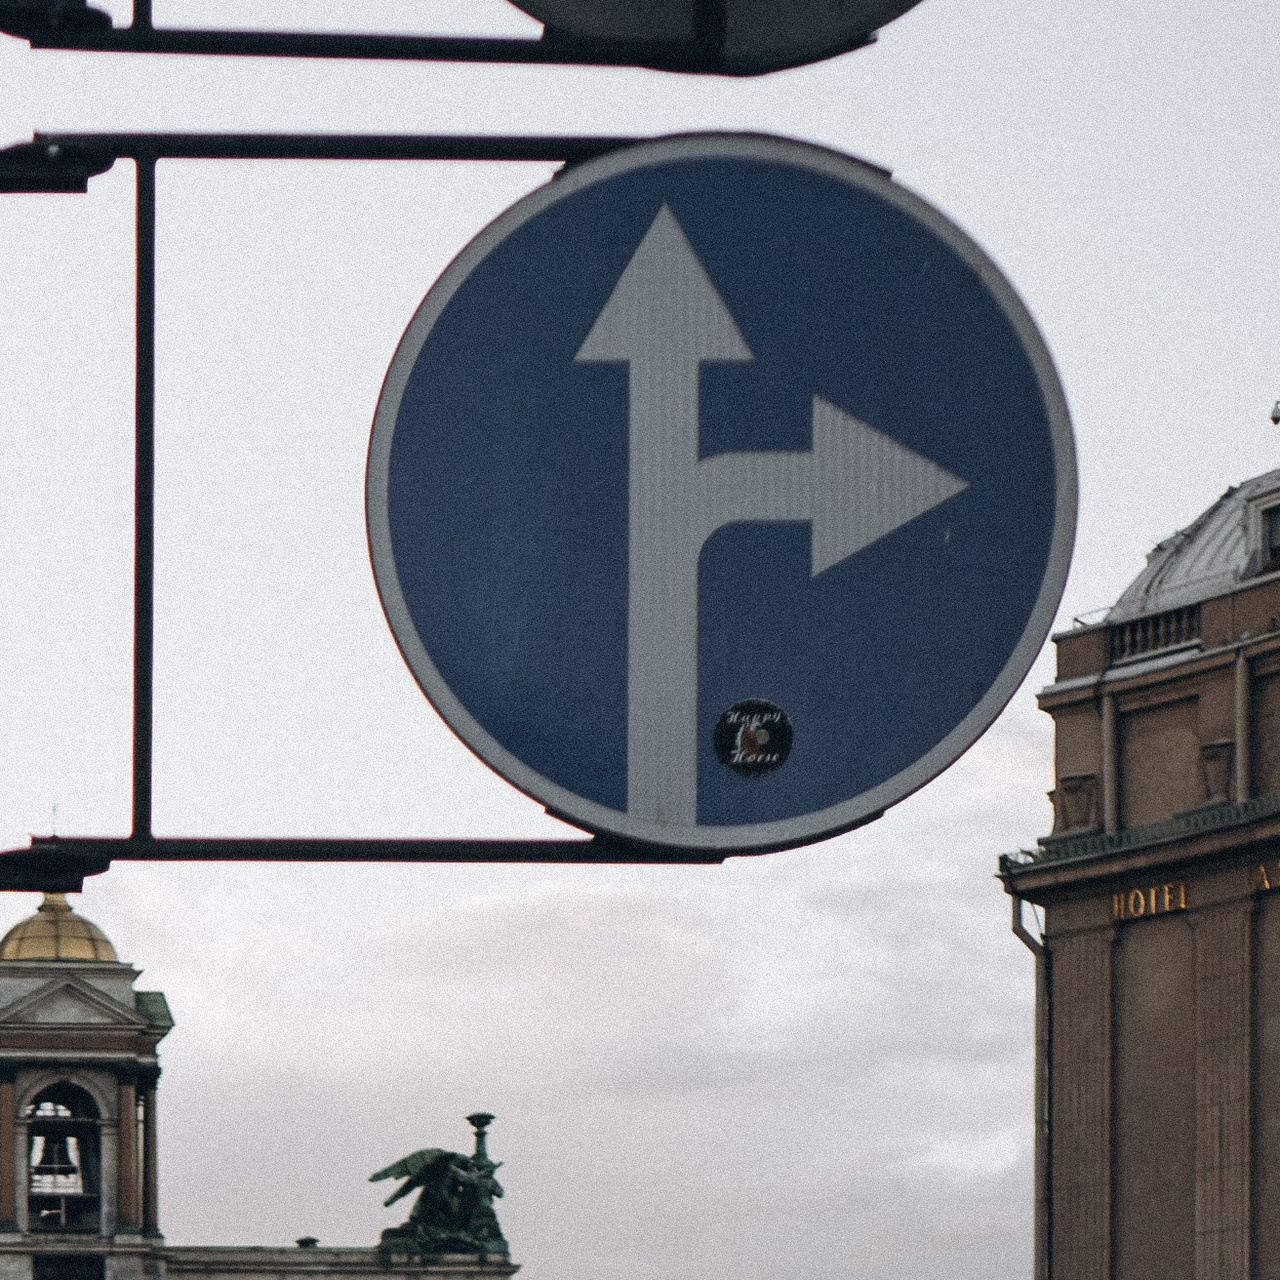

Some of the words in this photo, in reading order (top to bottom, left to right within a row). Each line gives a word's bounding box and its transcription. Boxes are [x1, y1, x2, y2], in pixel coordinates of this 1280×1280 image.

[726, 711, 782, 724] Happy
[730, 748, 780, 763] Horse
[1112, 881, 1187, 920] HOTEL
